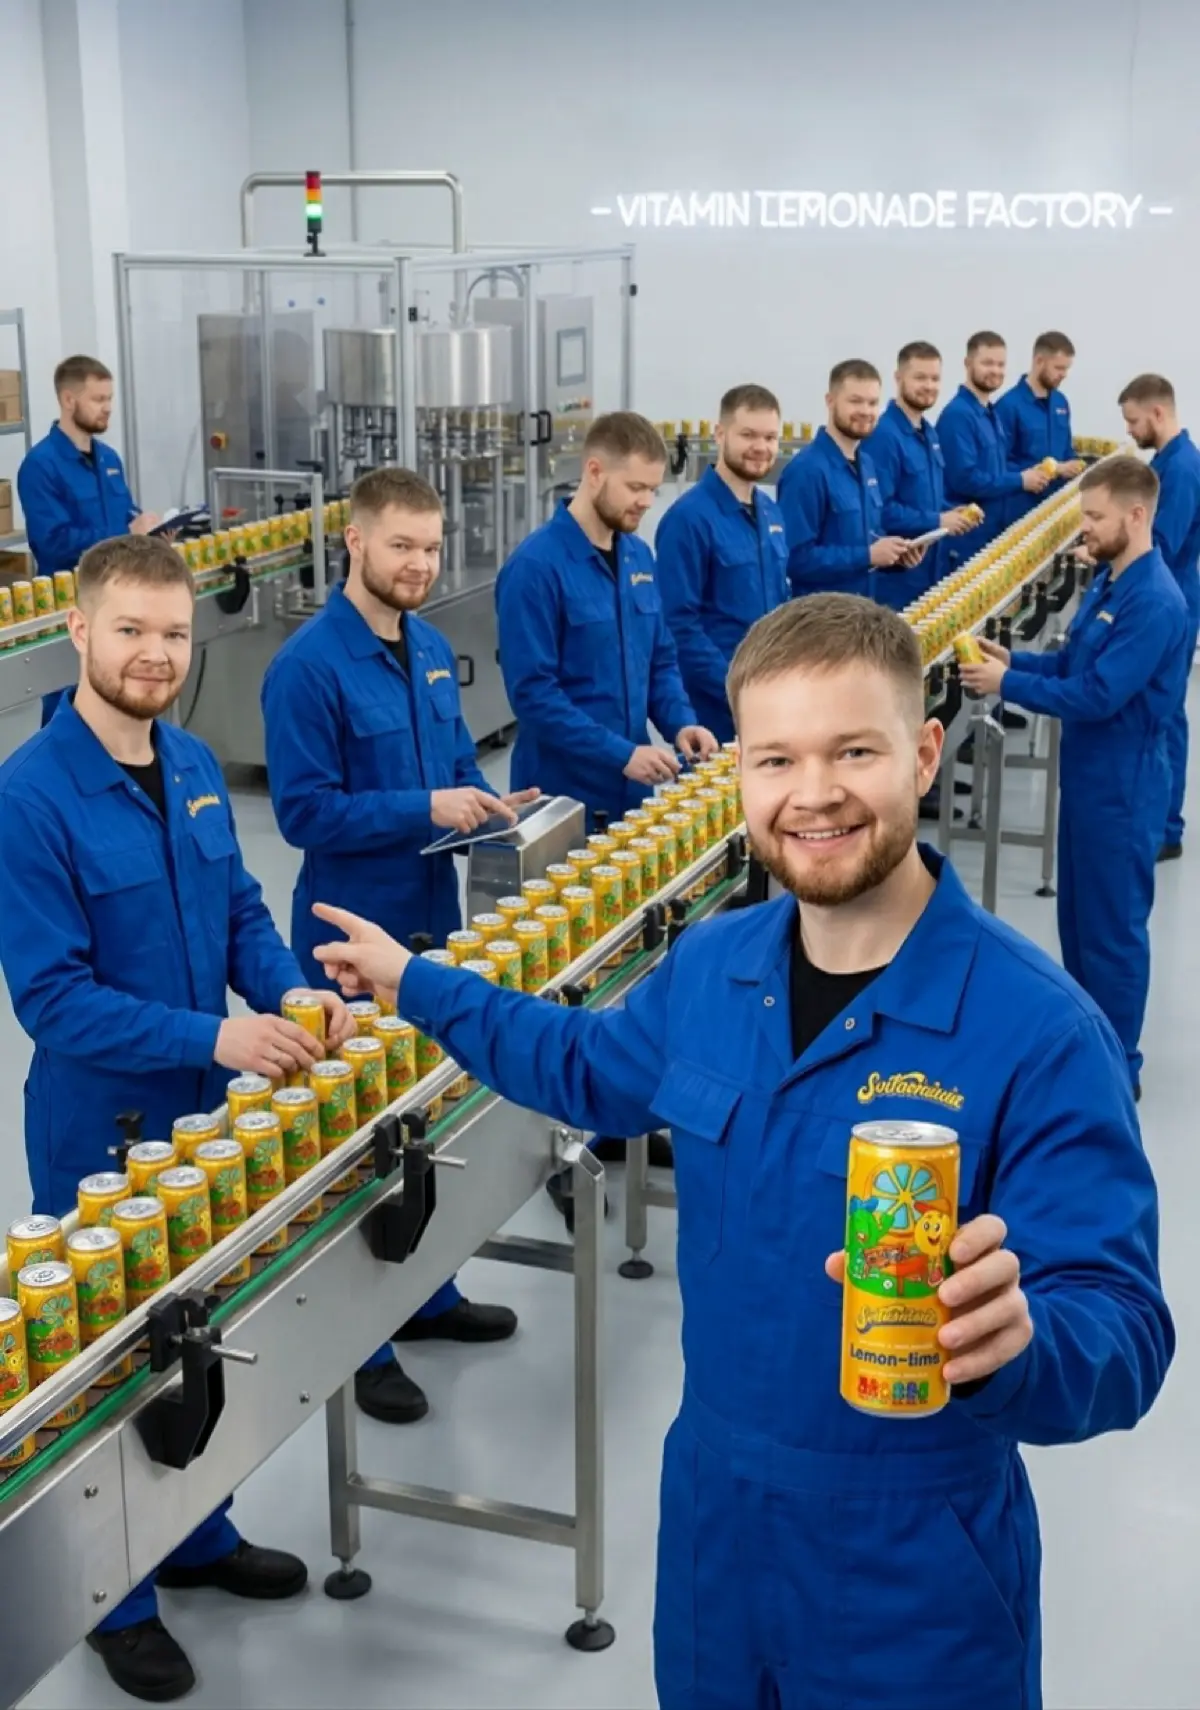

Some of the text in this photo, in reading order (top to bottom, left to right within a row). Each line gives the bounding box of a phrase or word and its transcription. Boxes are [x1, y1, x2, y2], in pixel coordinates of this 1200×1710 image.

[616, 190, 1142, 227] VITAMIN LEMONADE FACTORY
